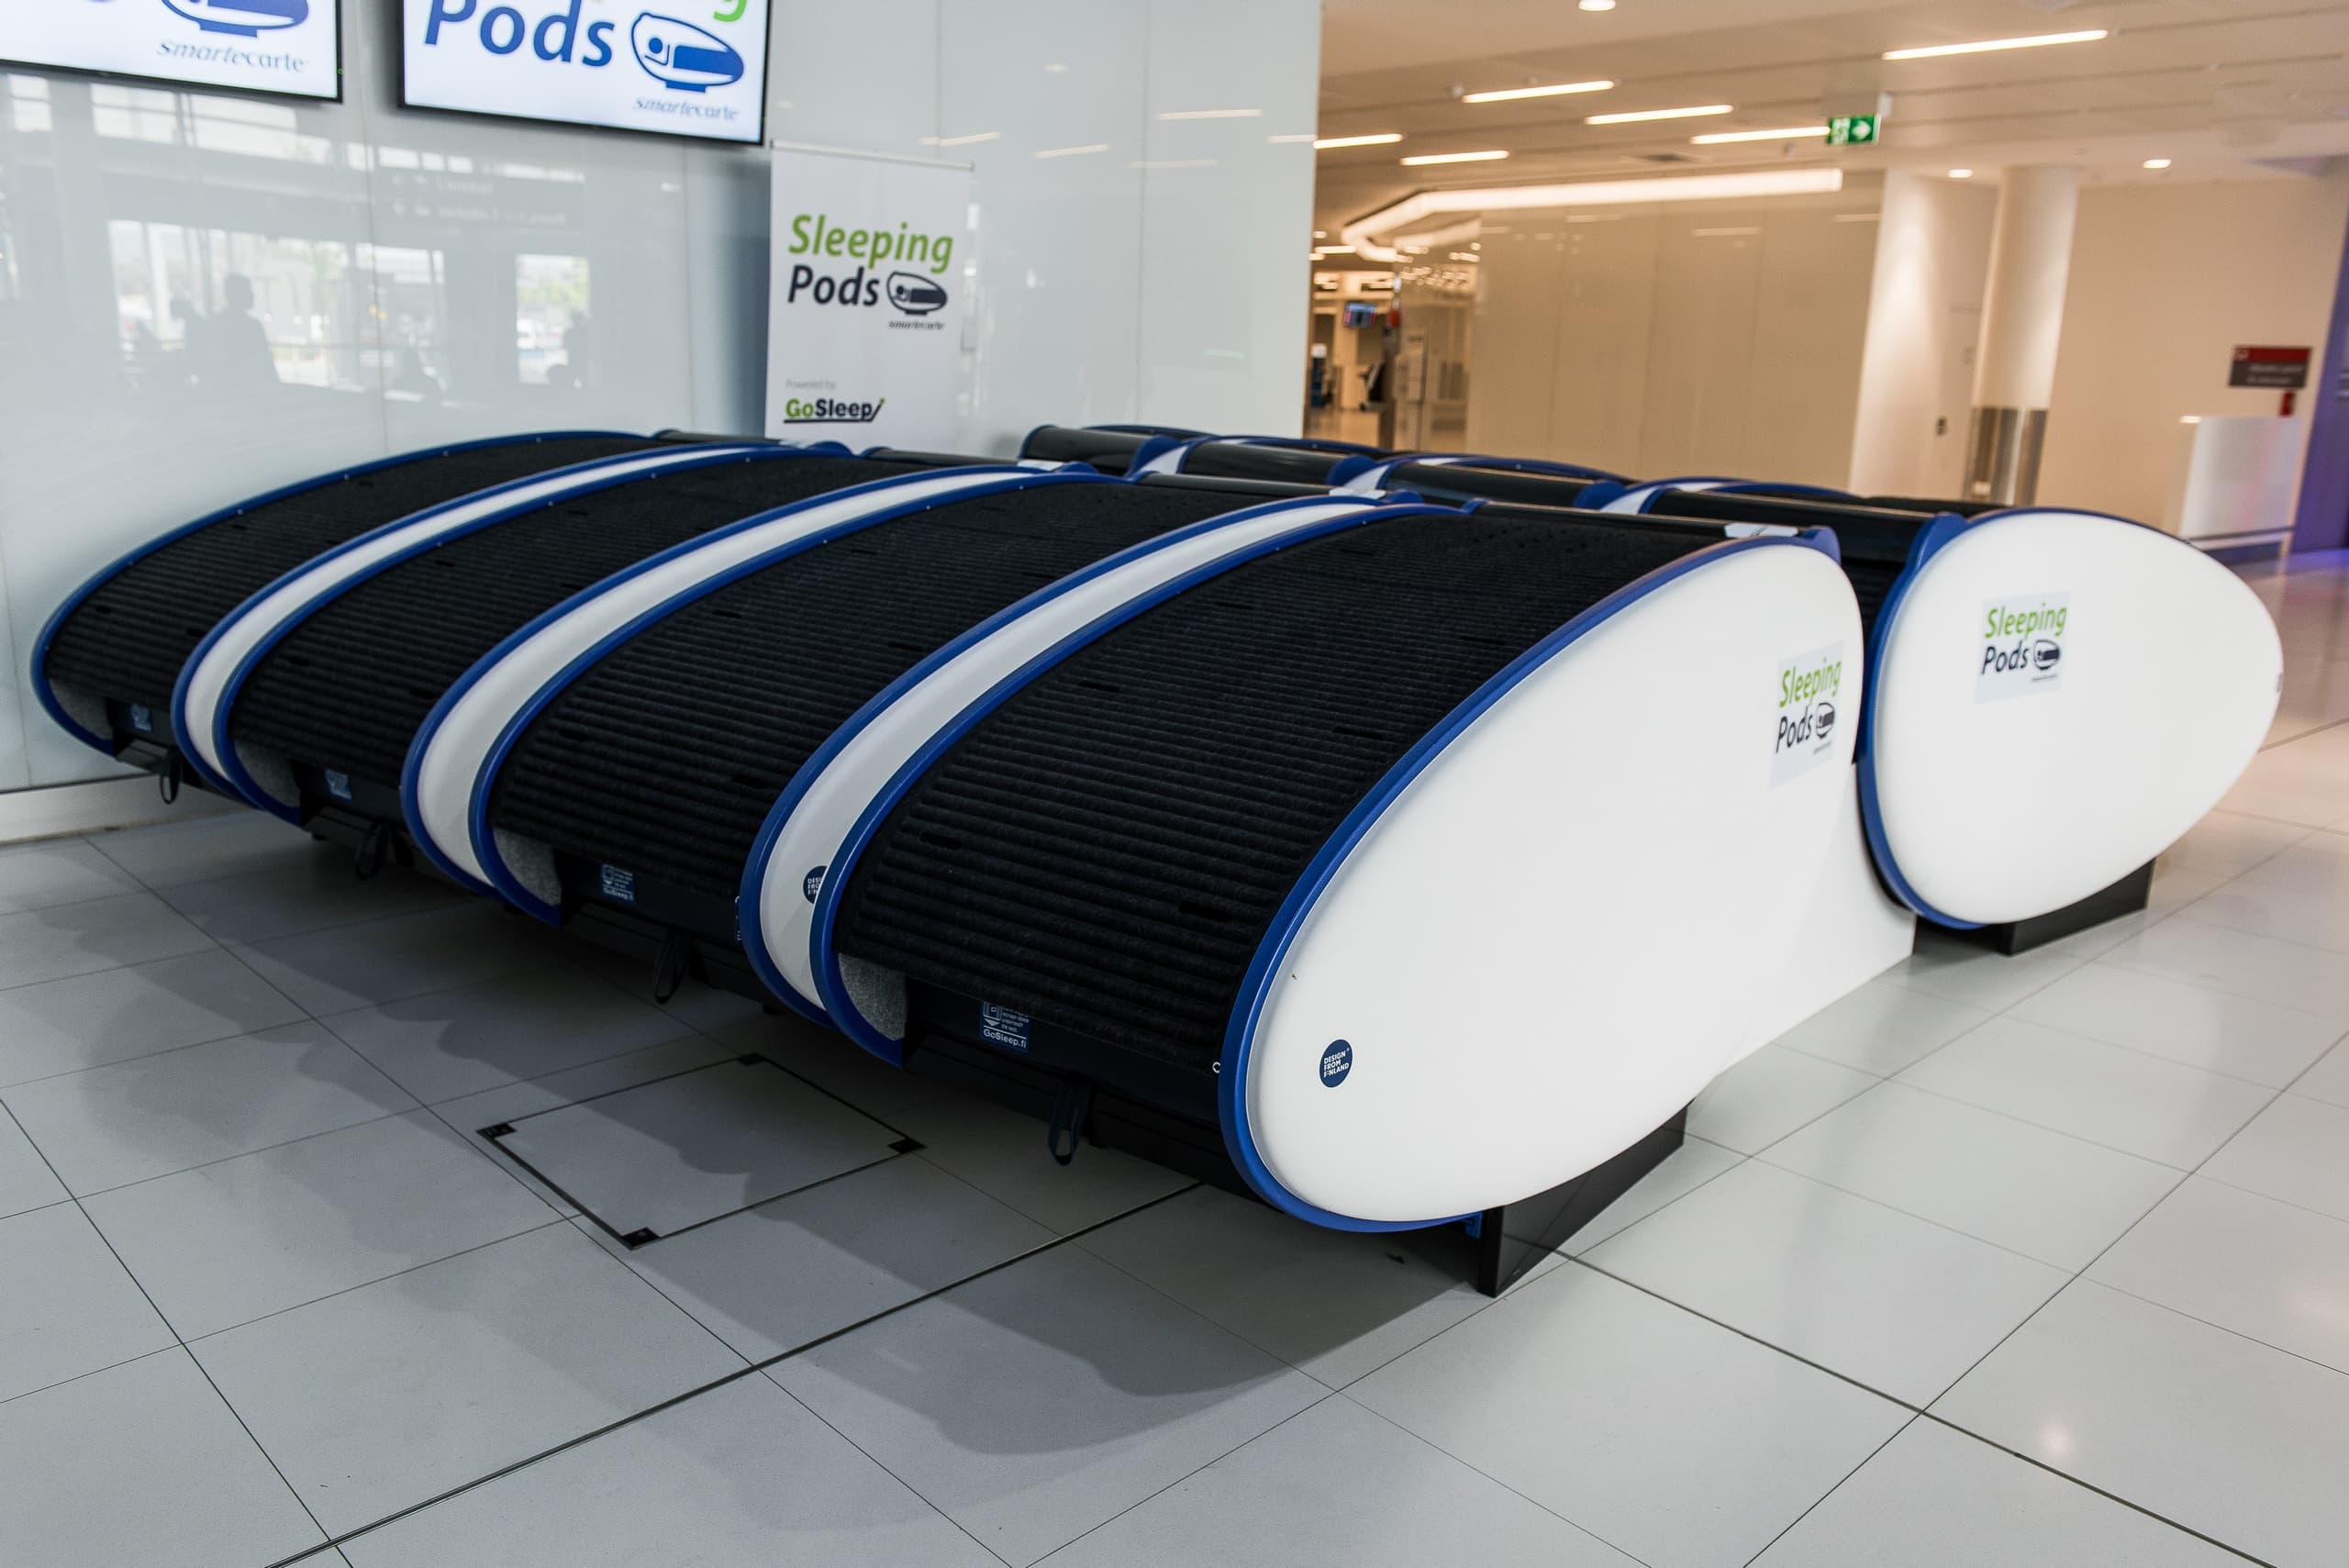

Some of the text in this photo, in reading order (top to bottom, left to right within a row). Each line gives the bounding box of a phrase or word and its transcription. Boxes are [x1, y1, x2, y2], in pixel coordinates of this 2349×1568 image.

[425, 0, 615, 67] Pods
[788, 215, 953, 273] Sleeping
[787, 265, 880, 306] Pods
[785, 398, 874, 422] GoSleep
[1985, 602, 2067, 639] Sleeping
[1981, 640, 2029, 674] Pods
[1779, 657, 1842, 707] Sleeping
[1776, 706, 1813, 753] Pods
[984, 1029, 1027, 1049] GoSleep.fi
[1324, 1051, 1346, 1064] DESIGN
[1324, 1059, 1341, 1072] FROM
